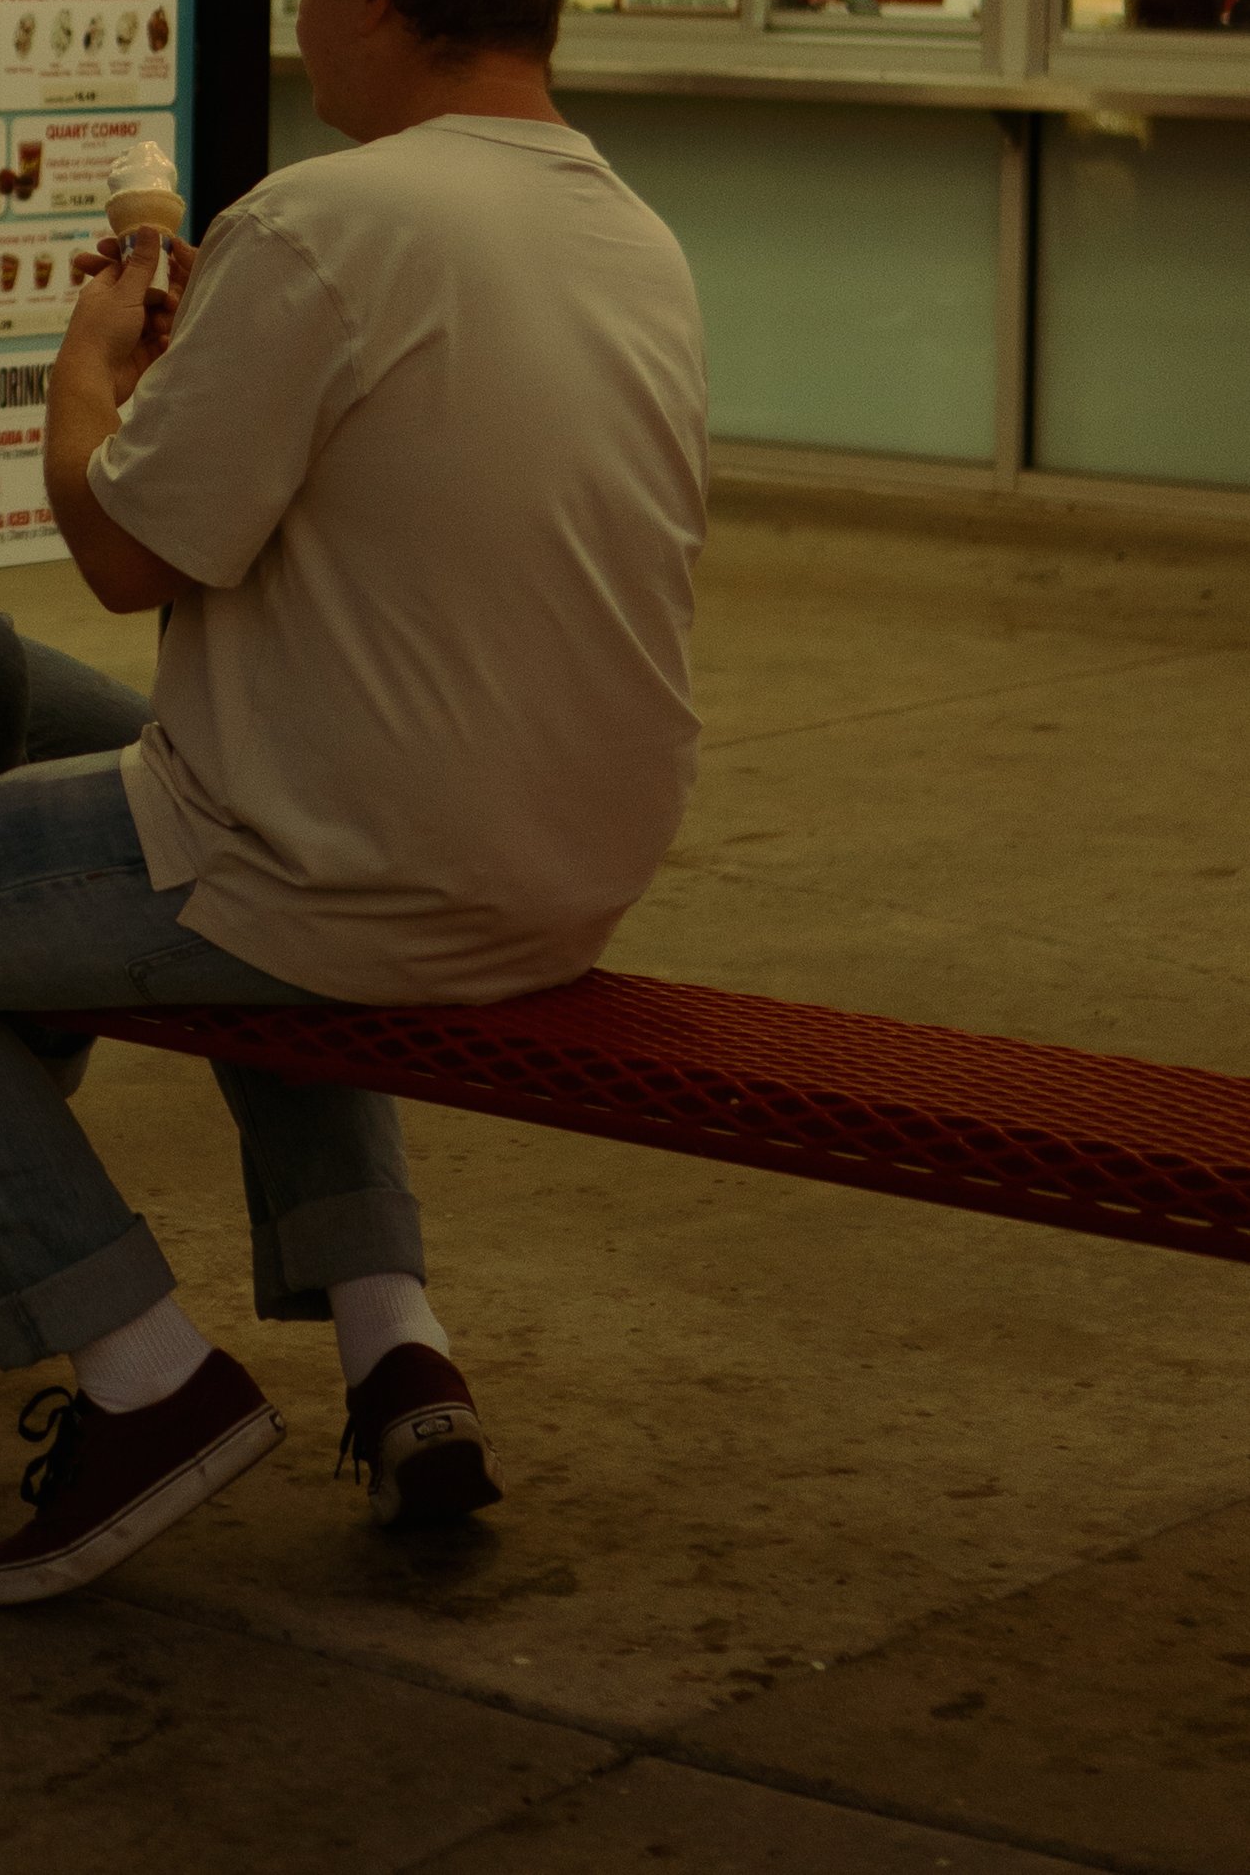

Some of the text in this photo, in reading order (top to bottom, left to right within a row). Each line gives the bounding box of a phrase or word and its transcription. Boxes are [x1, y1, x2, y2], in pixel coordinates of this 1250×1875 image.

[47, 121, 137, 141] QUART COMBO
[0, 363, 53, 410] DRINK
